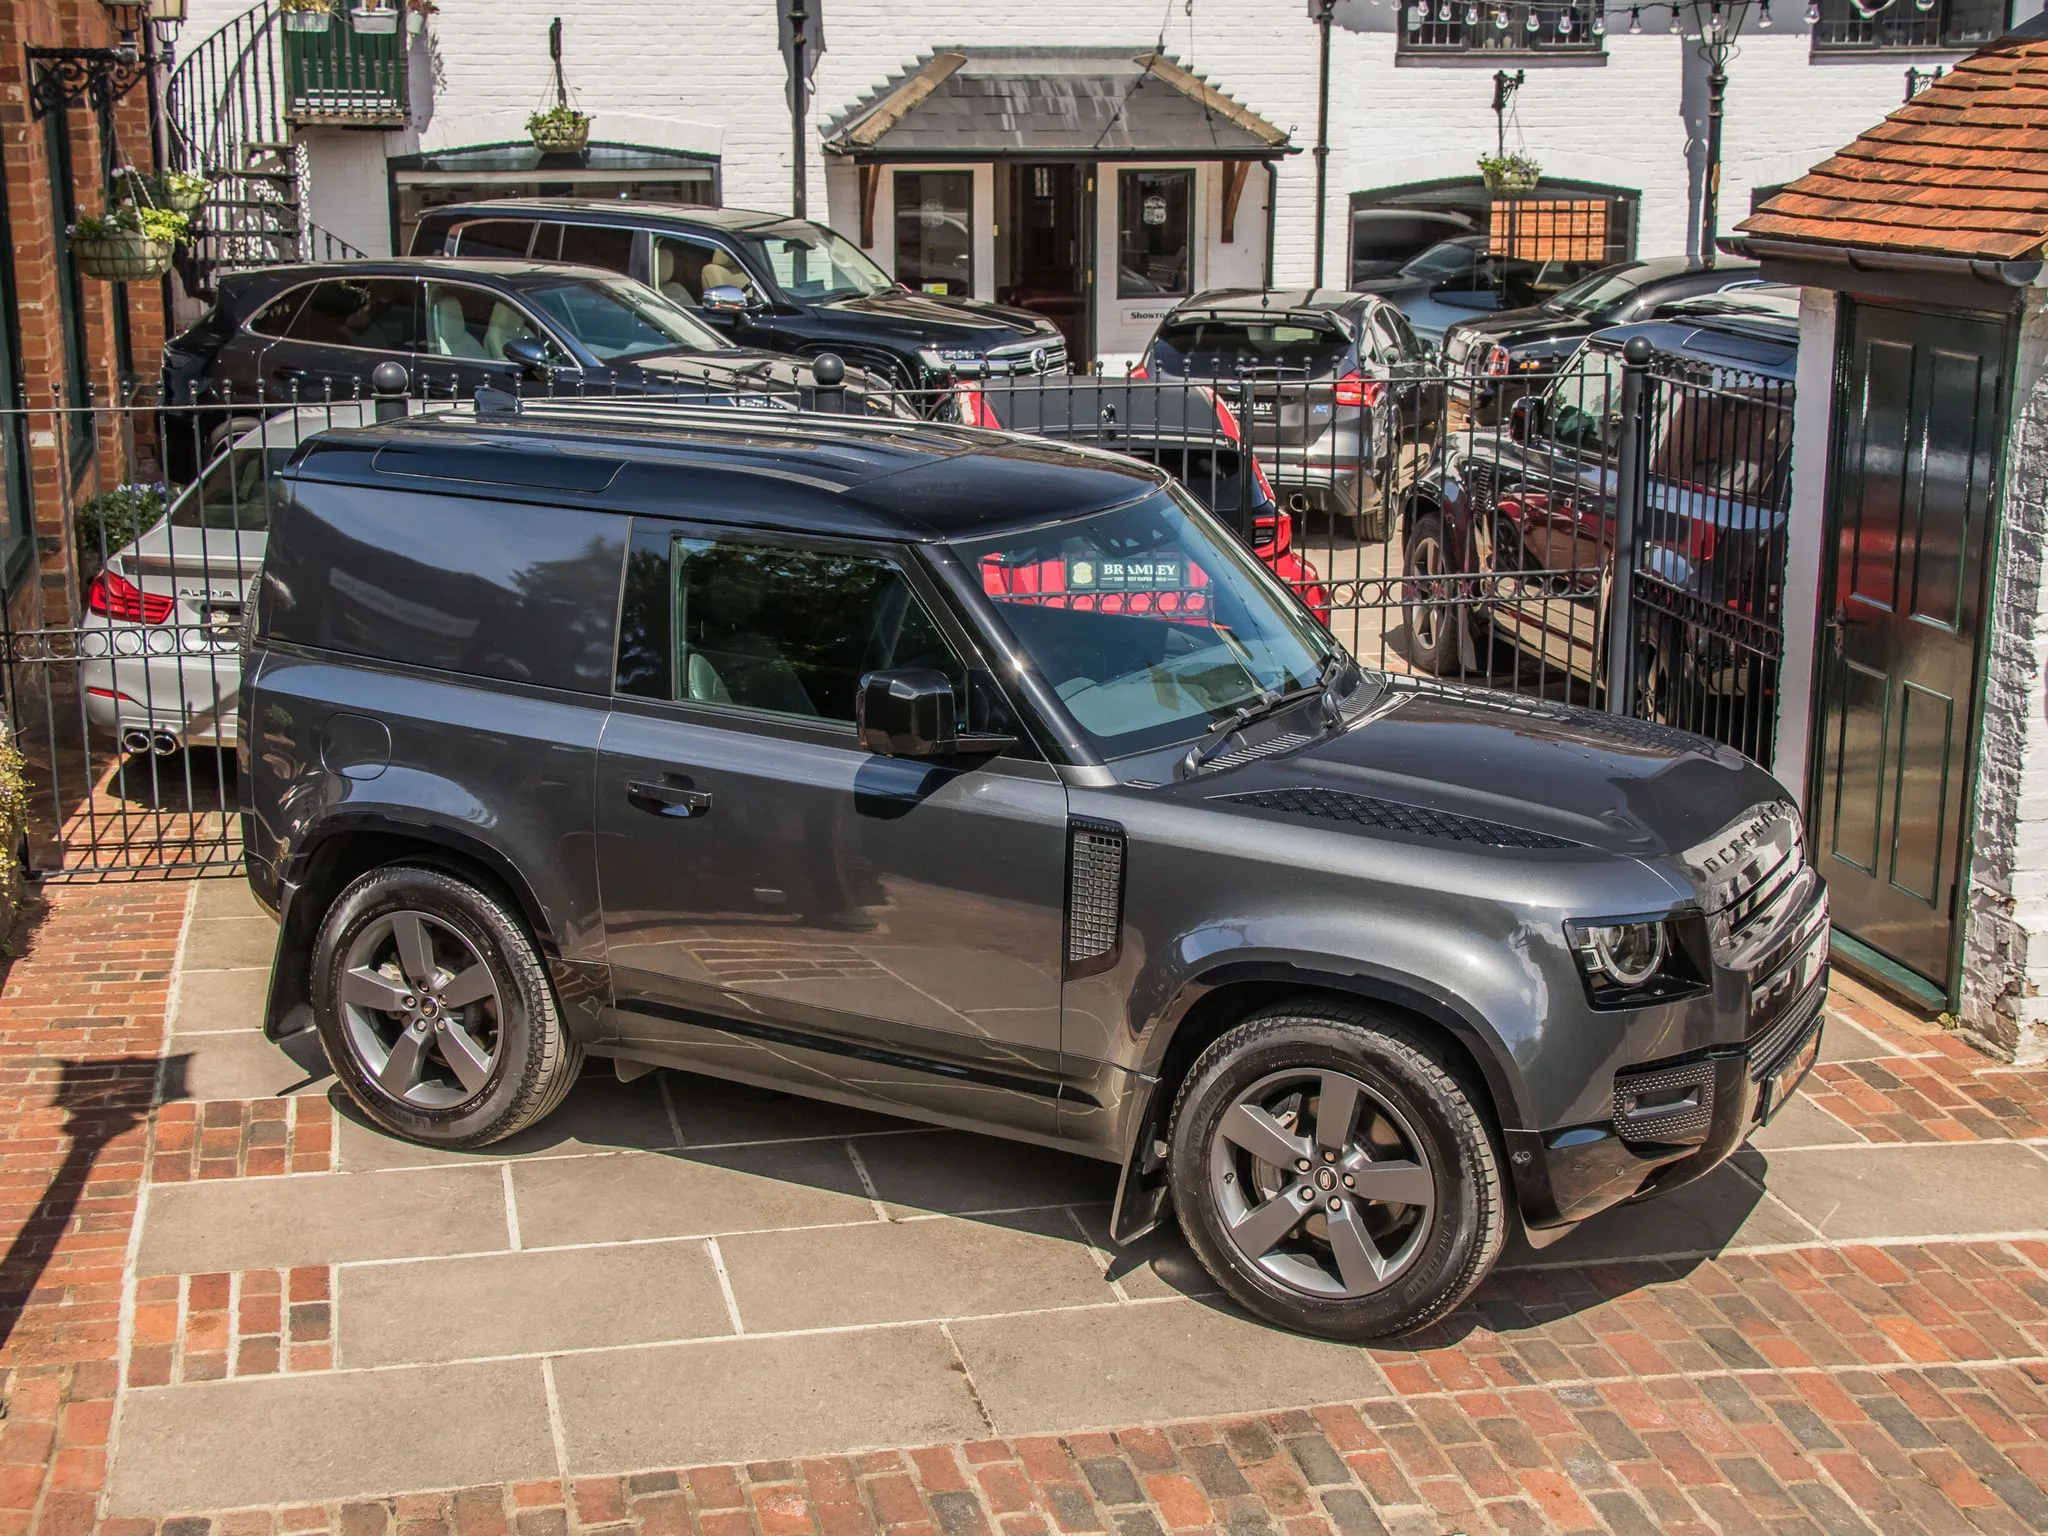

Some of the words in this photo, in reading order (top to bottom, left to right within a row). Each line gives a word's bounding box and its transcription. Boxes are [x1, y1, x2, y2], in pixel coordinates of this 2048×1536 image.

[1130, 312, 1166, 320] Showro
[1225, 401, 1272, 411] RALEY
[180, 588, 236, 599] ALPNA
[1703, 796, 1788, 874] DEFENDER
